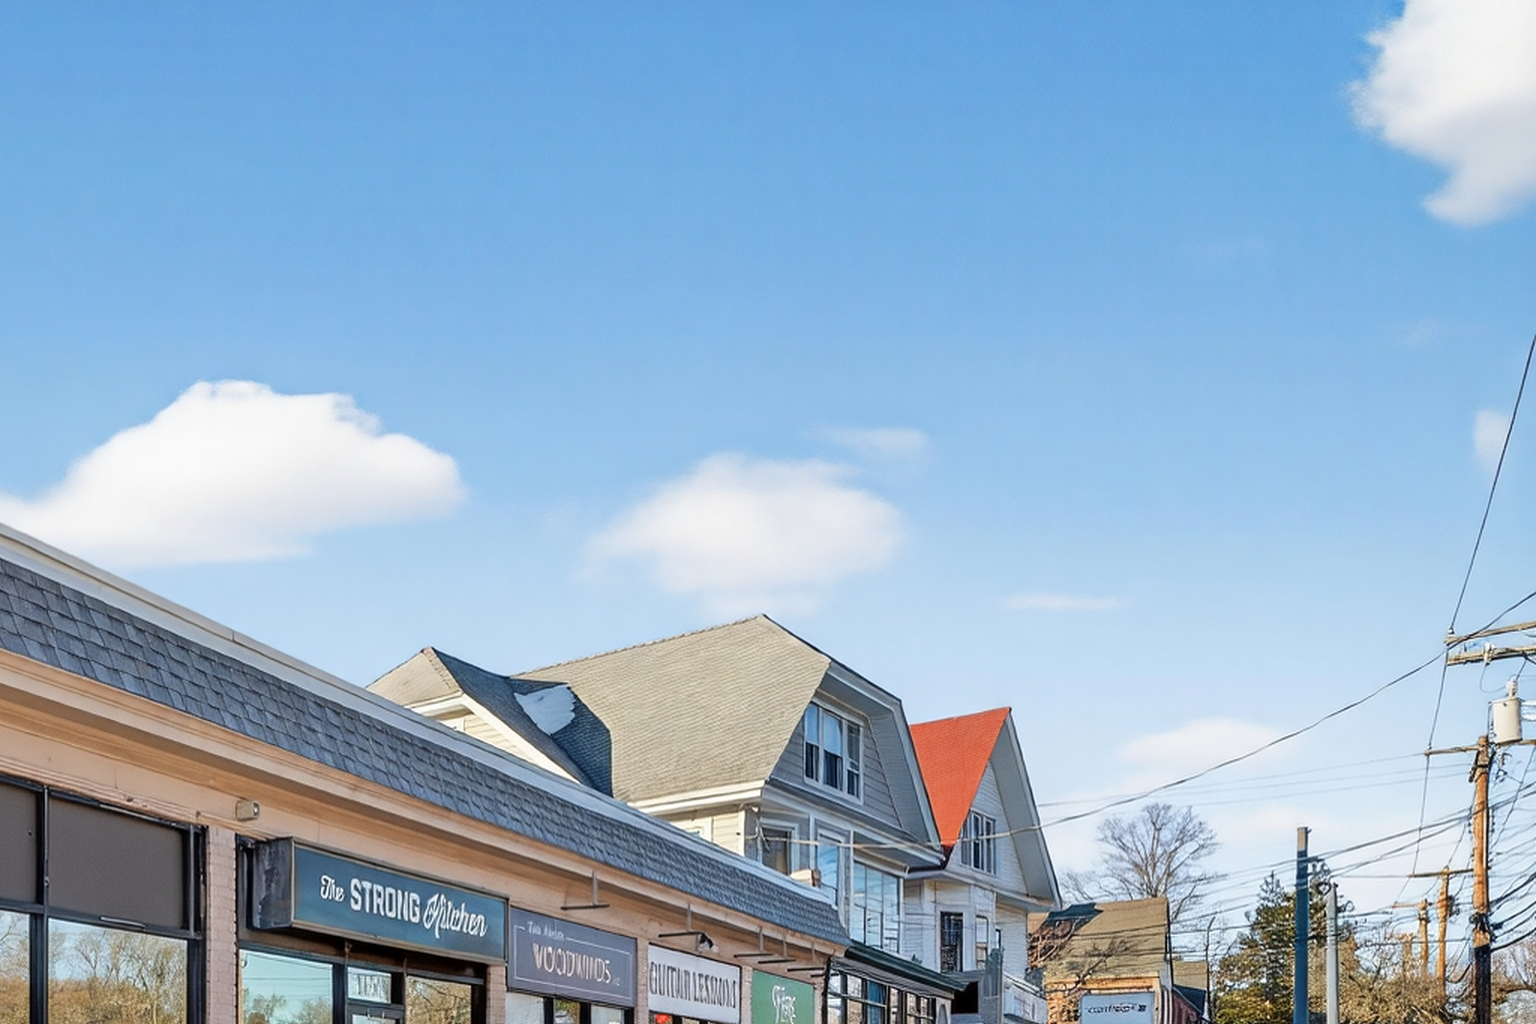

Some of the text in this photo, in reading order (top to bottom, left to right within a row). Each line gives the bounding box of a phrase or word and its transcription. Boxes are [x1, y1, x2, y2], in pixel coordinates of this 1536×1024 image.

[320, 874, 345, 902] The
[350, 878, 420, 923] STRONG
[423, 893, 487, 939] Kitchen
